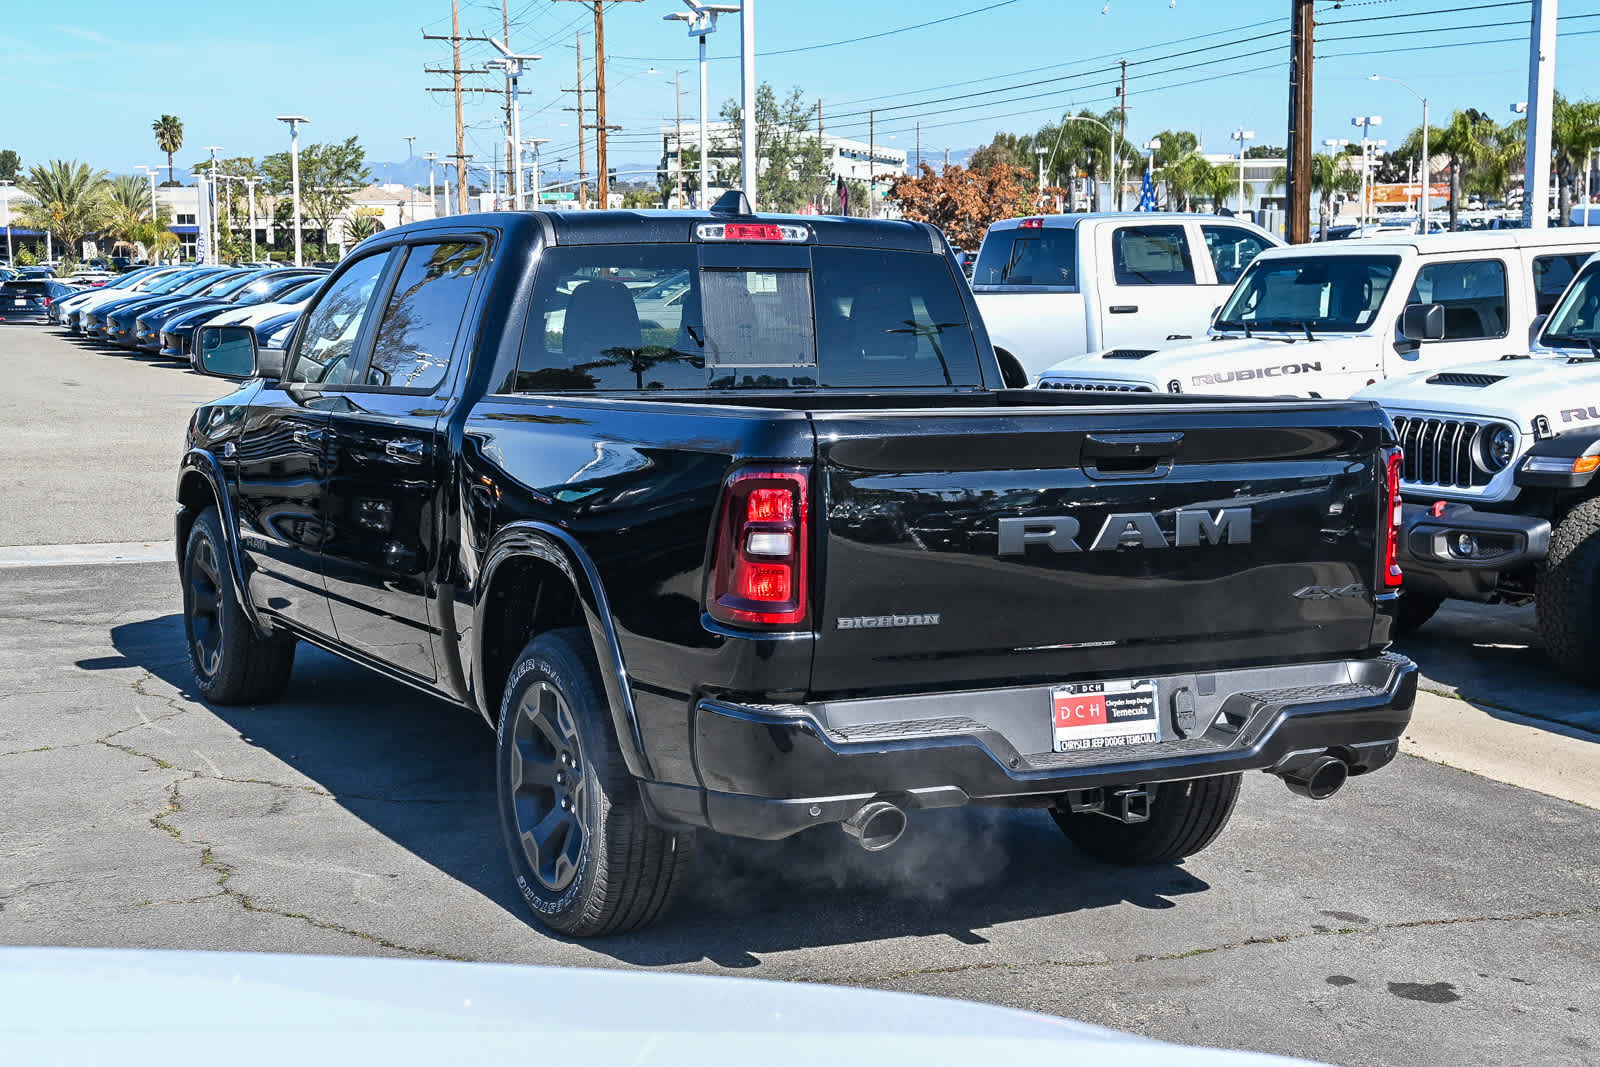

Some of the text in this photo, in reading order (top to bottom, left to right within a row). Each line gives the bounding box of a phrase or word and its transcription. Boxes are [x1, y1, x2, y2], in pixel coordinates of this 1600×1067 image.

[1192, 361, 1322, 387] RUBICON
[998, 508, 1252, 555] RAM
[837, 615, 940, 629] BIGHORN
[1060, 703, 1100, 720] DCH
[1111, 706, 1148, 717] Temecula
[1061, 733, 1156, 750] CHRYSLER JEEP DODGE TEMECULA
